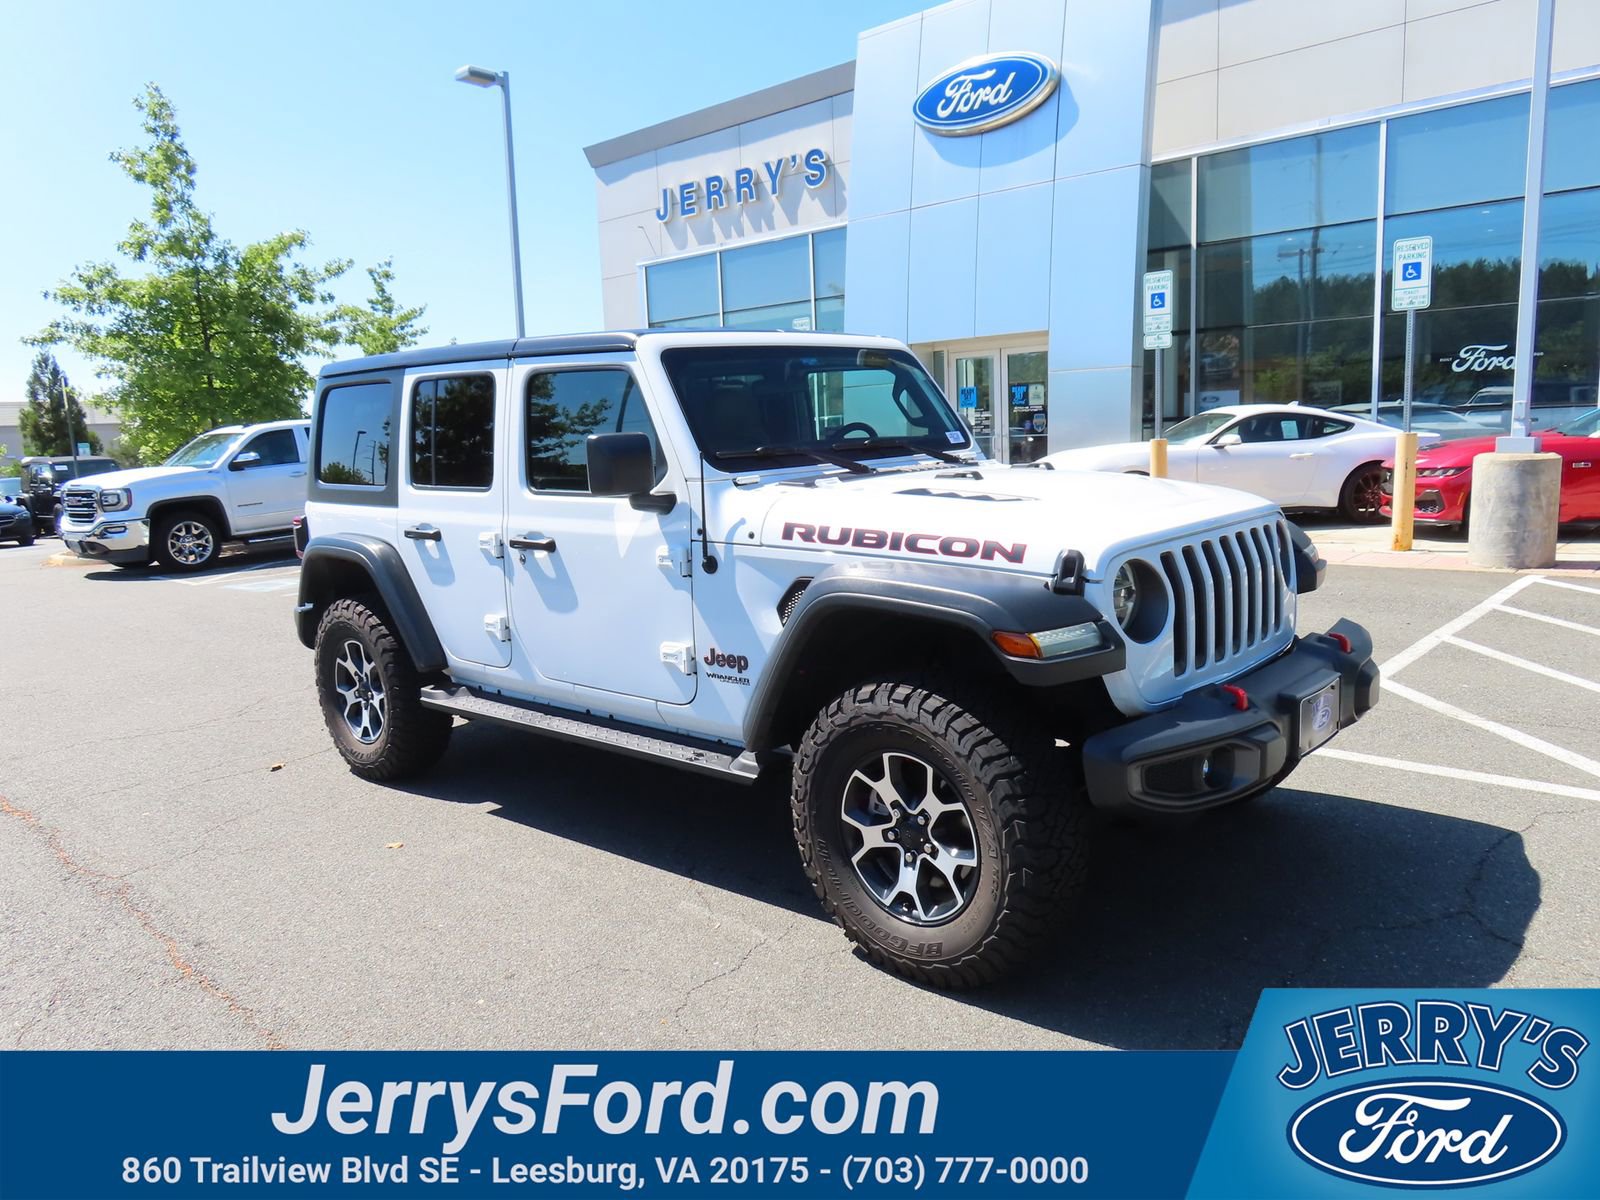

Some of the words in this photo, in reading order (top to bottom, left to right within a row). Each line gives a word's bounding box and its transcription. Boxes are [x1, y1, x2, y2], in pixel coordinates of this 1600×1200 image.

[937, 68, 1017, 118] Ford
[655, 148, 828, 223] JERRY'S
[1397, 242, 1429, 252] RESERVED
[1399, 252, 1427, 261] PARKING
[781, 522, 1028, 564] RUBICON
[703, 648, 749, 674] Jeep
[706, 672, 750, 683] WRANGLER
